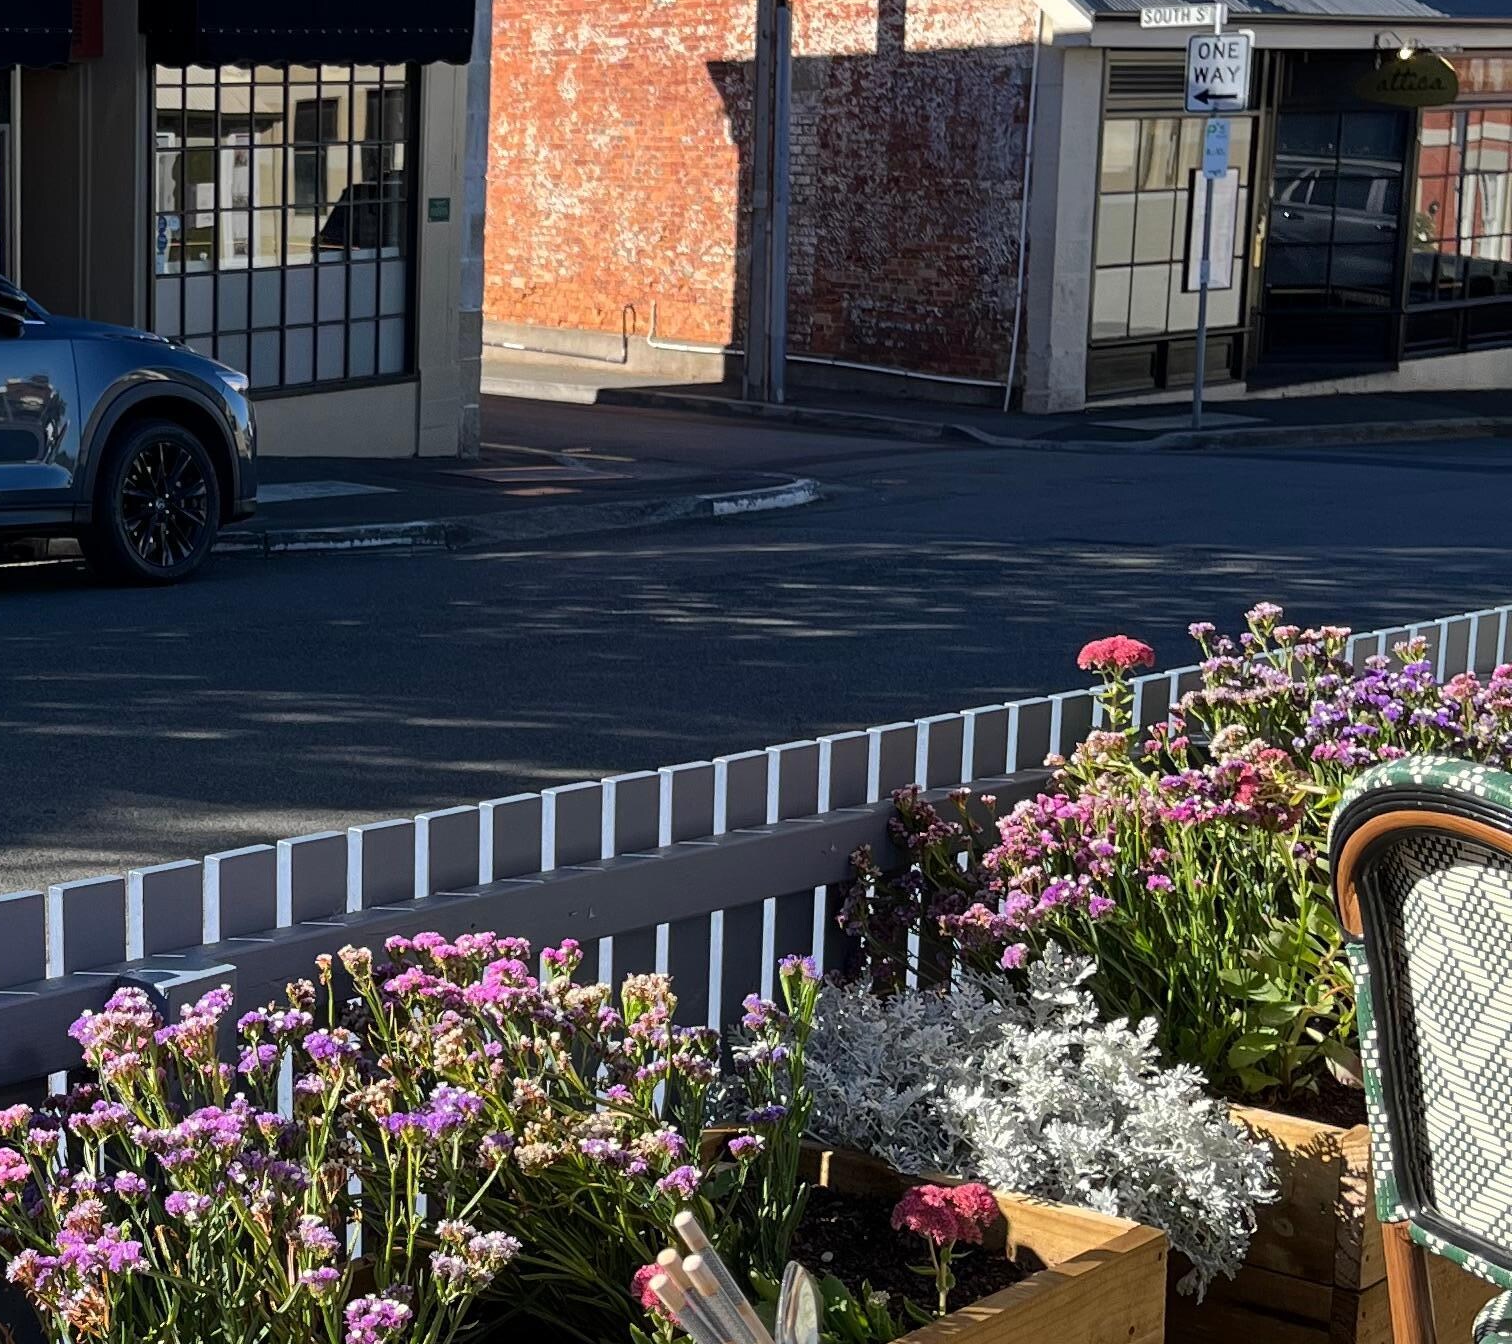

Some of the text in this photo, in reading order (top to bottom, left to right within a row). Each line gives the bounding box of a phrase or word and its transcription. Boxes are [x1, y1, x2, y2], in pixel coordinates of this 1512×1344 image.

[1143, 7, 1191, 25] SOUTH
[1199, 42, 1240, 59] ONE
[1194, 67, 1241, 84] WAY
